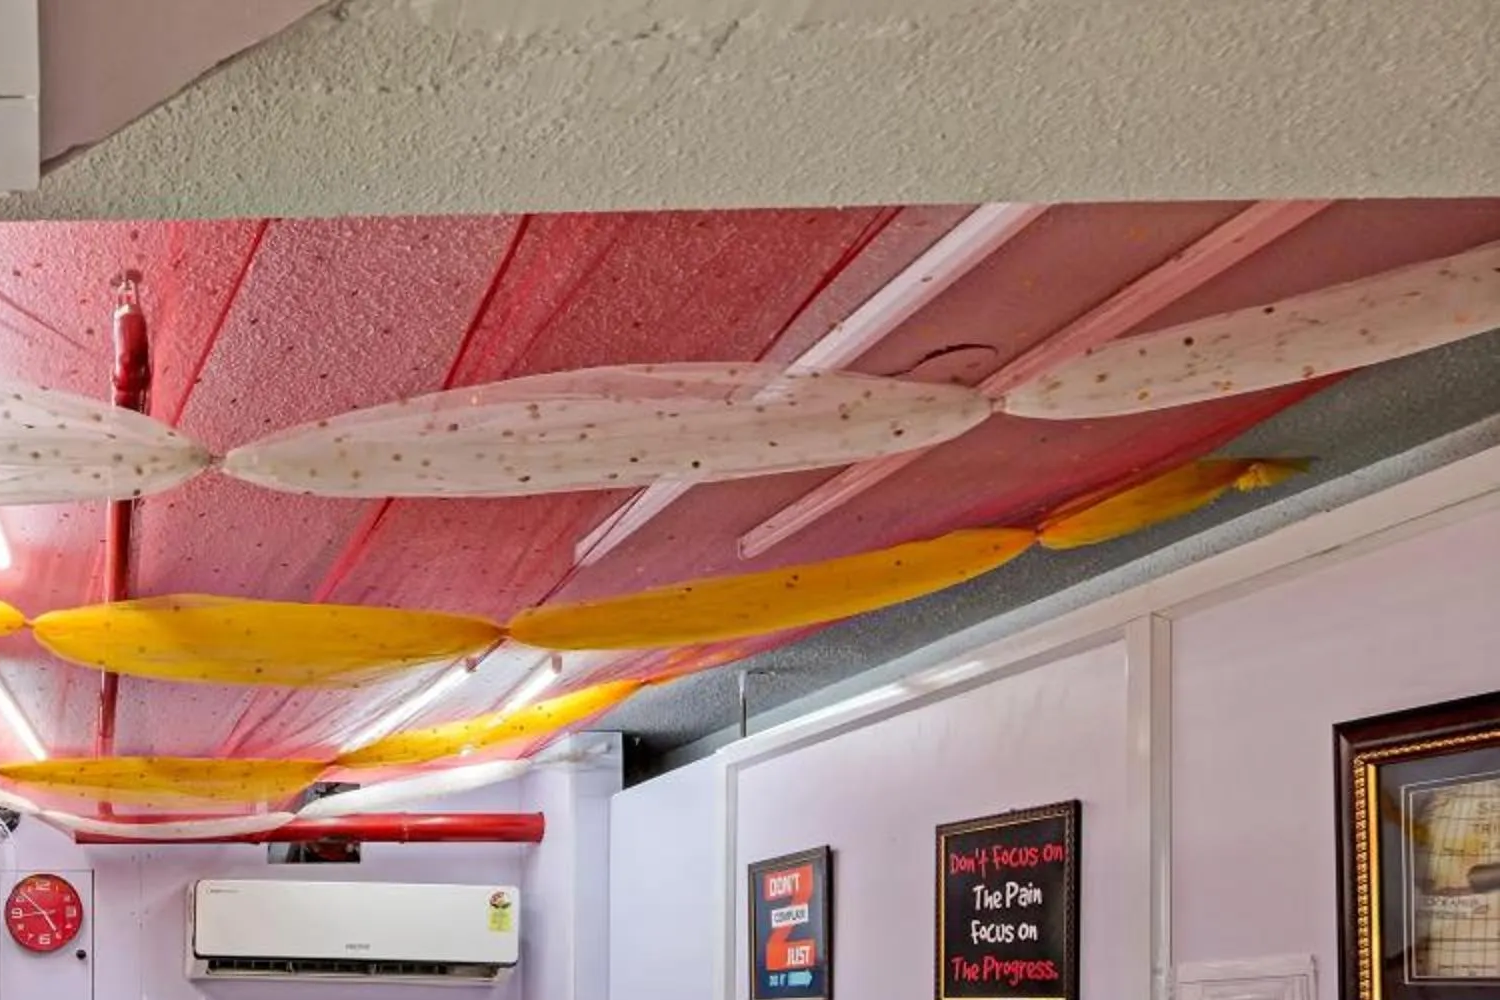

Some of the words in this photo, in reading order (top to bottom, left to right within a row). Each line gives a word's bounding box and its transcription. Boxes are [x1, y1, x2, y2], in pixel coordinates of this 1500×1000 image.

[950, 848, 988, 878] Don't
[769, 873, 800, 897] DON'T
[973, 885, 1002, 910] The
[1005, 881, 1043, 908] Pain
[787, 945, 810, 965] JUST
[952, 956, 980, 981] The
